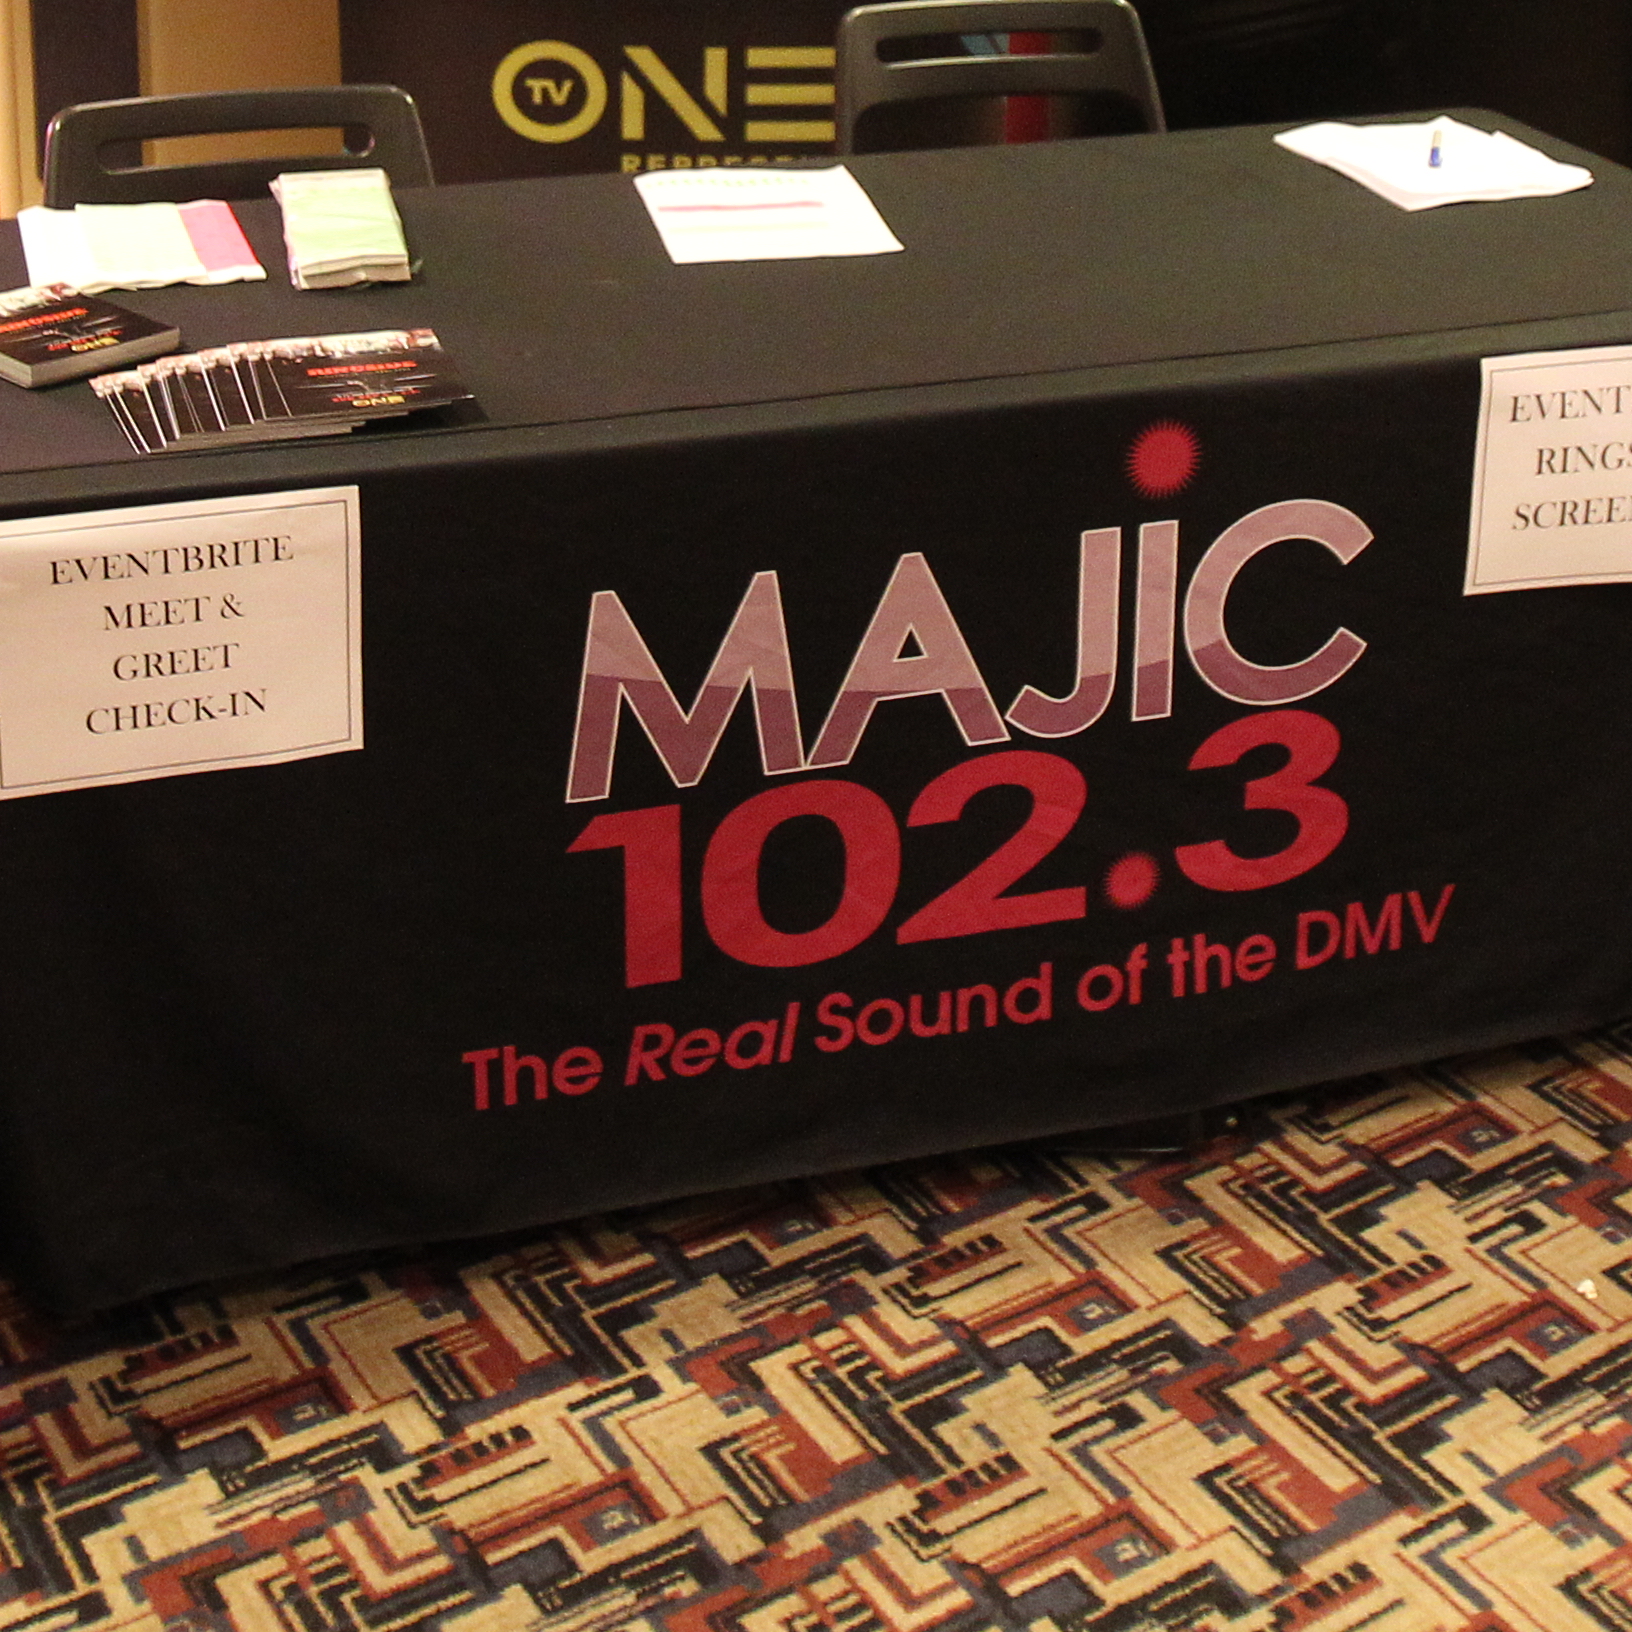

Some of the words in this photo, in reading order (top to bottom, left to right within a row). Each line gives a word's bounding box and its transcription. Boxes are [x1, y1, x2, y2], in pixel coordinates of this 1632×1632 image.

[491, 39, 836, 145] ONE
[524, 77, 574, 107] TV
[50, 535, 295, 586] EVENTBRITE
[104, 597, 211, 631] MEET
[220, 593, 244, 619] &
[565, 420, 1374, 804] MAJIC
[113, 642, 240, 682] GREET
[85, 688, 269, 735] CHECK-IN
[565, 709, 1350, 989] 102.3
[461, 1038, 604, 1110] The
[624, 1002, 799, 1086] Real
[813, 962, 1055, 1054] Sound
[1075, 942, 1149, 1013] of
[1165, 931, 1278, 996] the
[1292, 883, 1457, 970] DMV
